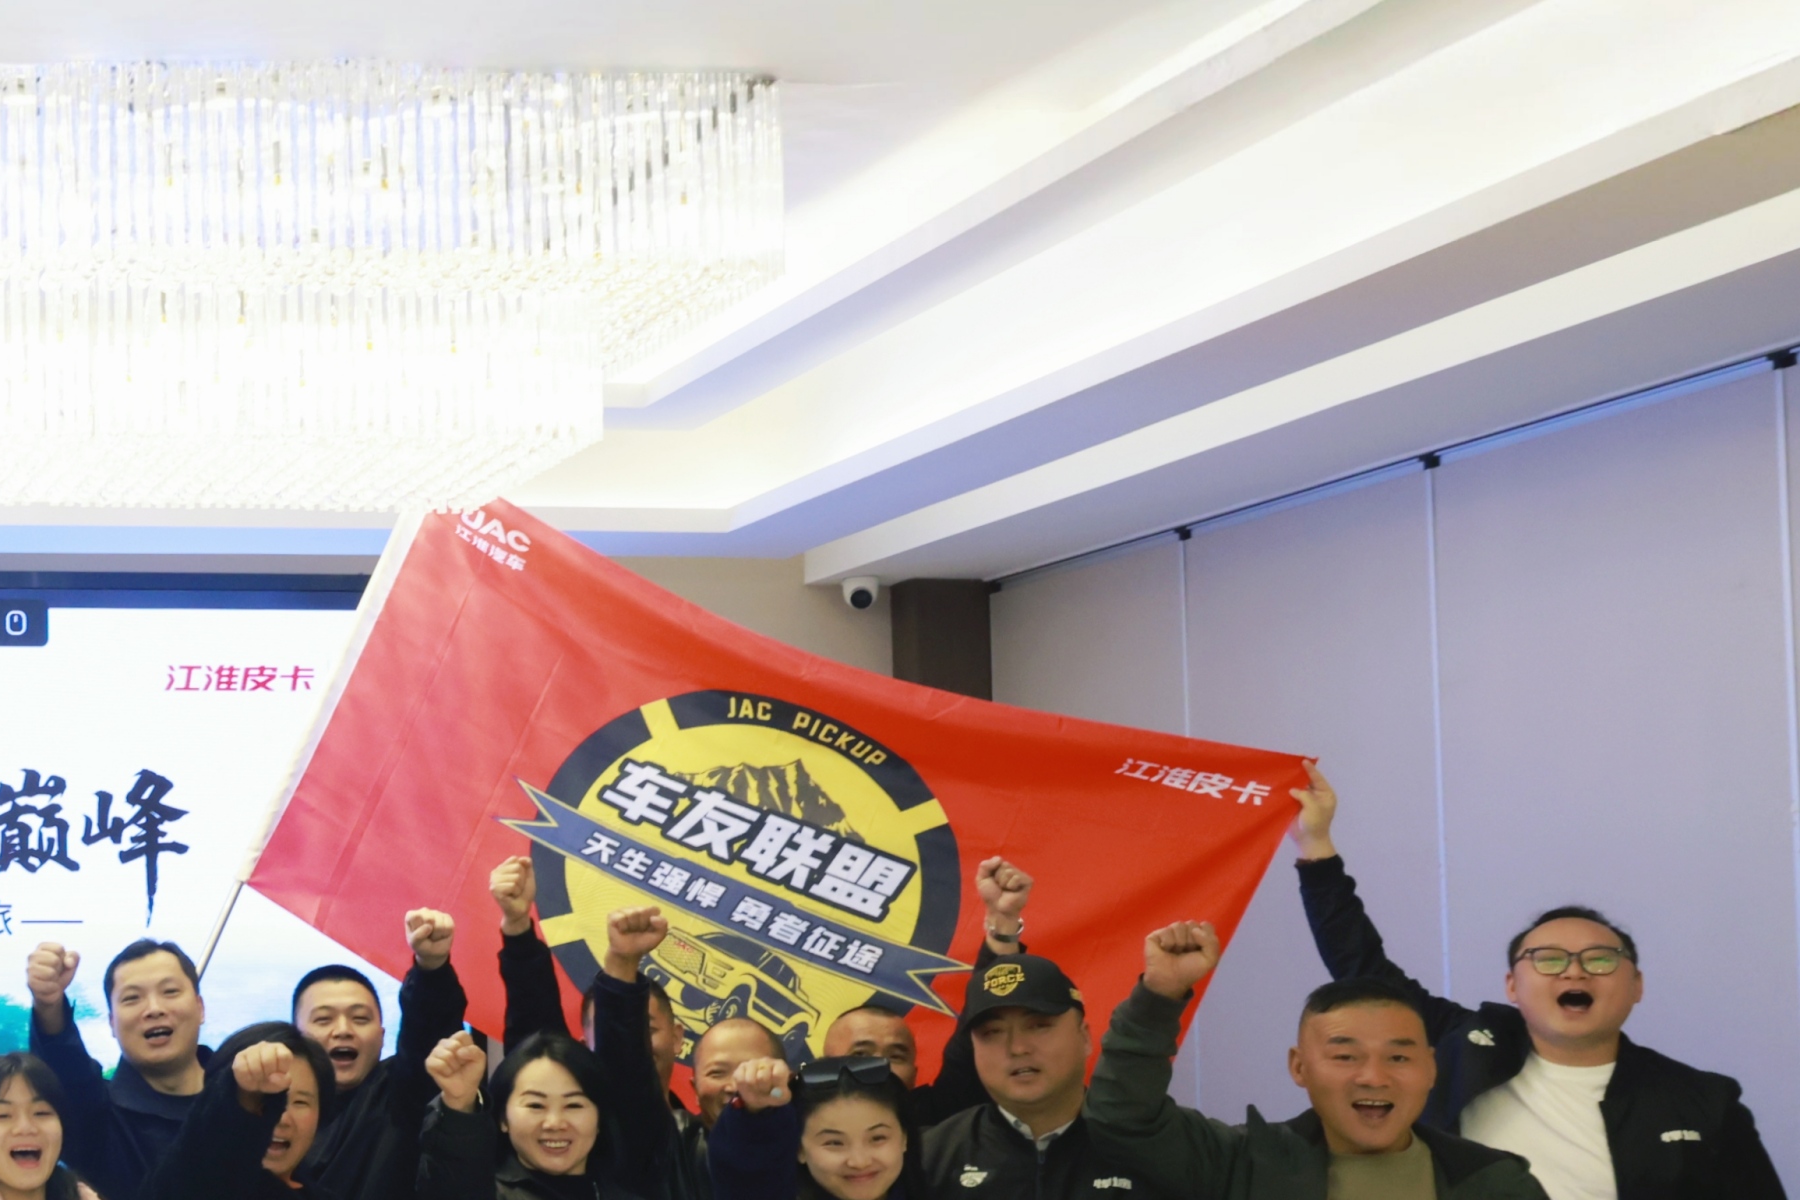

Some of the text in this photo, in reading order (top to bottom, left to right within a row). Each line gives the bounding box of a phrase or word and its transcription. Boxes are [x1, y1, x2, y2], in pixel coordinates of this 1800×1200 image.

[165, 664, 314, 691] 江淮皮卡
[727, 697, 887, 765] JAC PICKUP
[1114, 758, 1272, 806] 江淮皮卡
[602, 761, 912, 918] 车友联盟
[580, 831, 884, 975] 天生强悍 勇者征途
[983, 973, 1026, 991] FORCE
